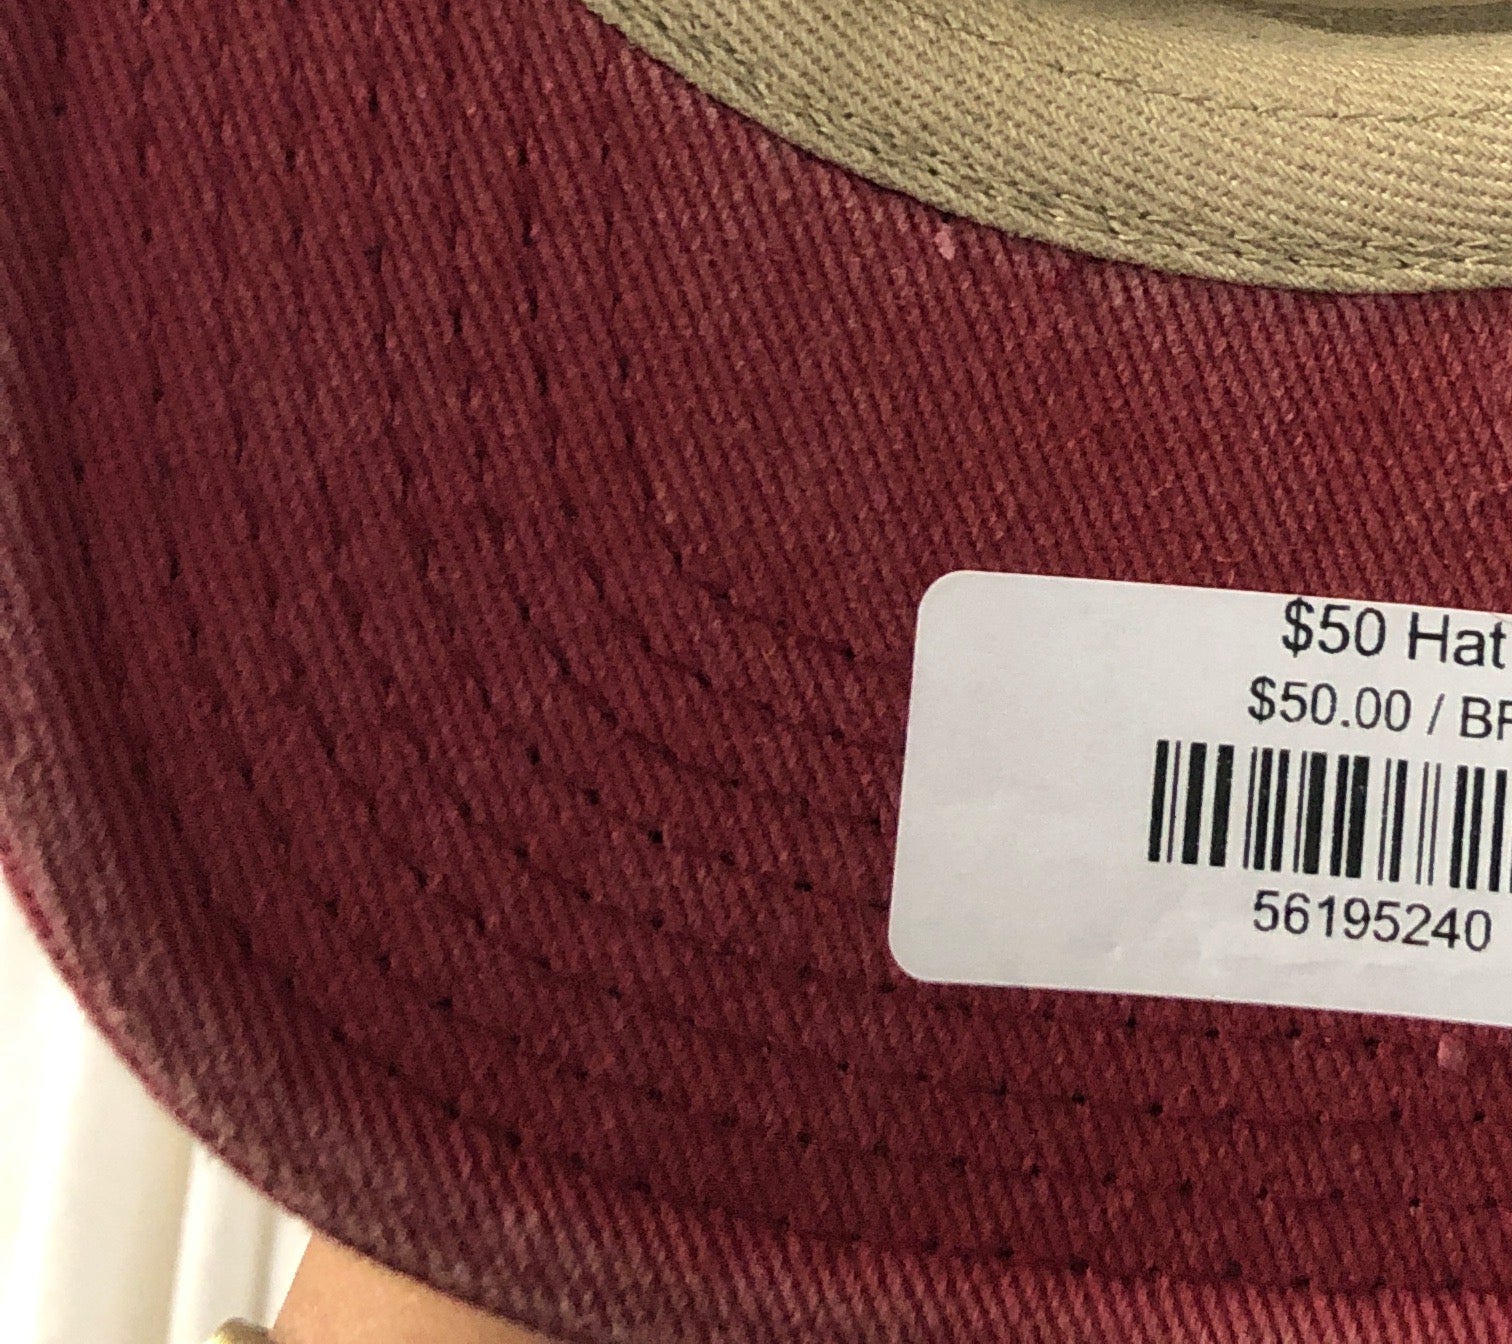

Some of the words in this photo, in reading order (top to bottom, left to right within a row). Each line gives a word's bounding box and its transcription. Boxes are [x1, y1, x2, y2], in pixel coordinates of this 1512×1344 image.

[1281, 596, 1387, 659] $50
[1407, 611, 1508, 671] Hat
[1247, 675, 1413, 733] $50.00
[1427, 693, 1445, 736] /
[1252, 889, 1493, 953] 56195240
